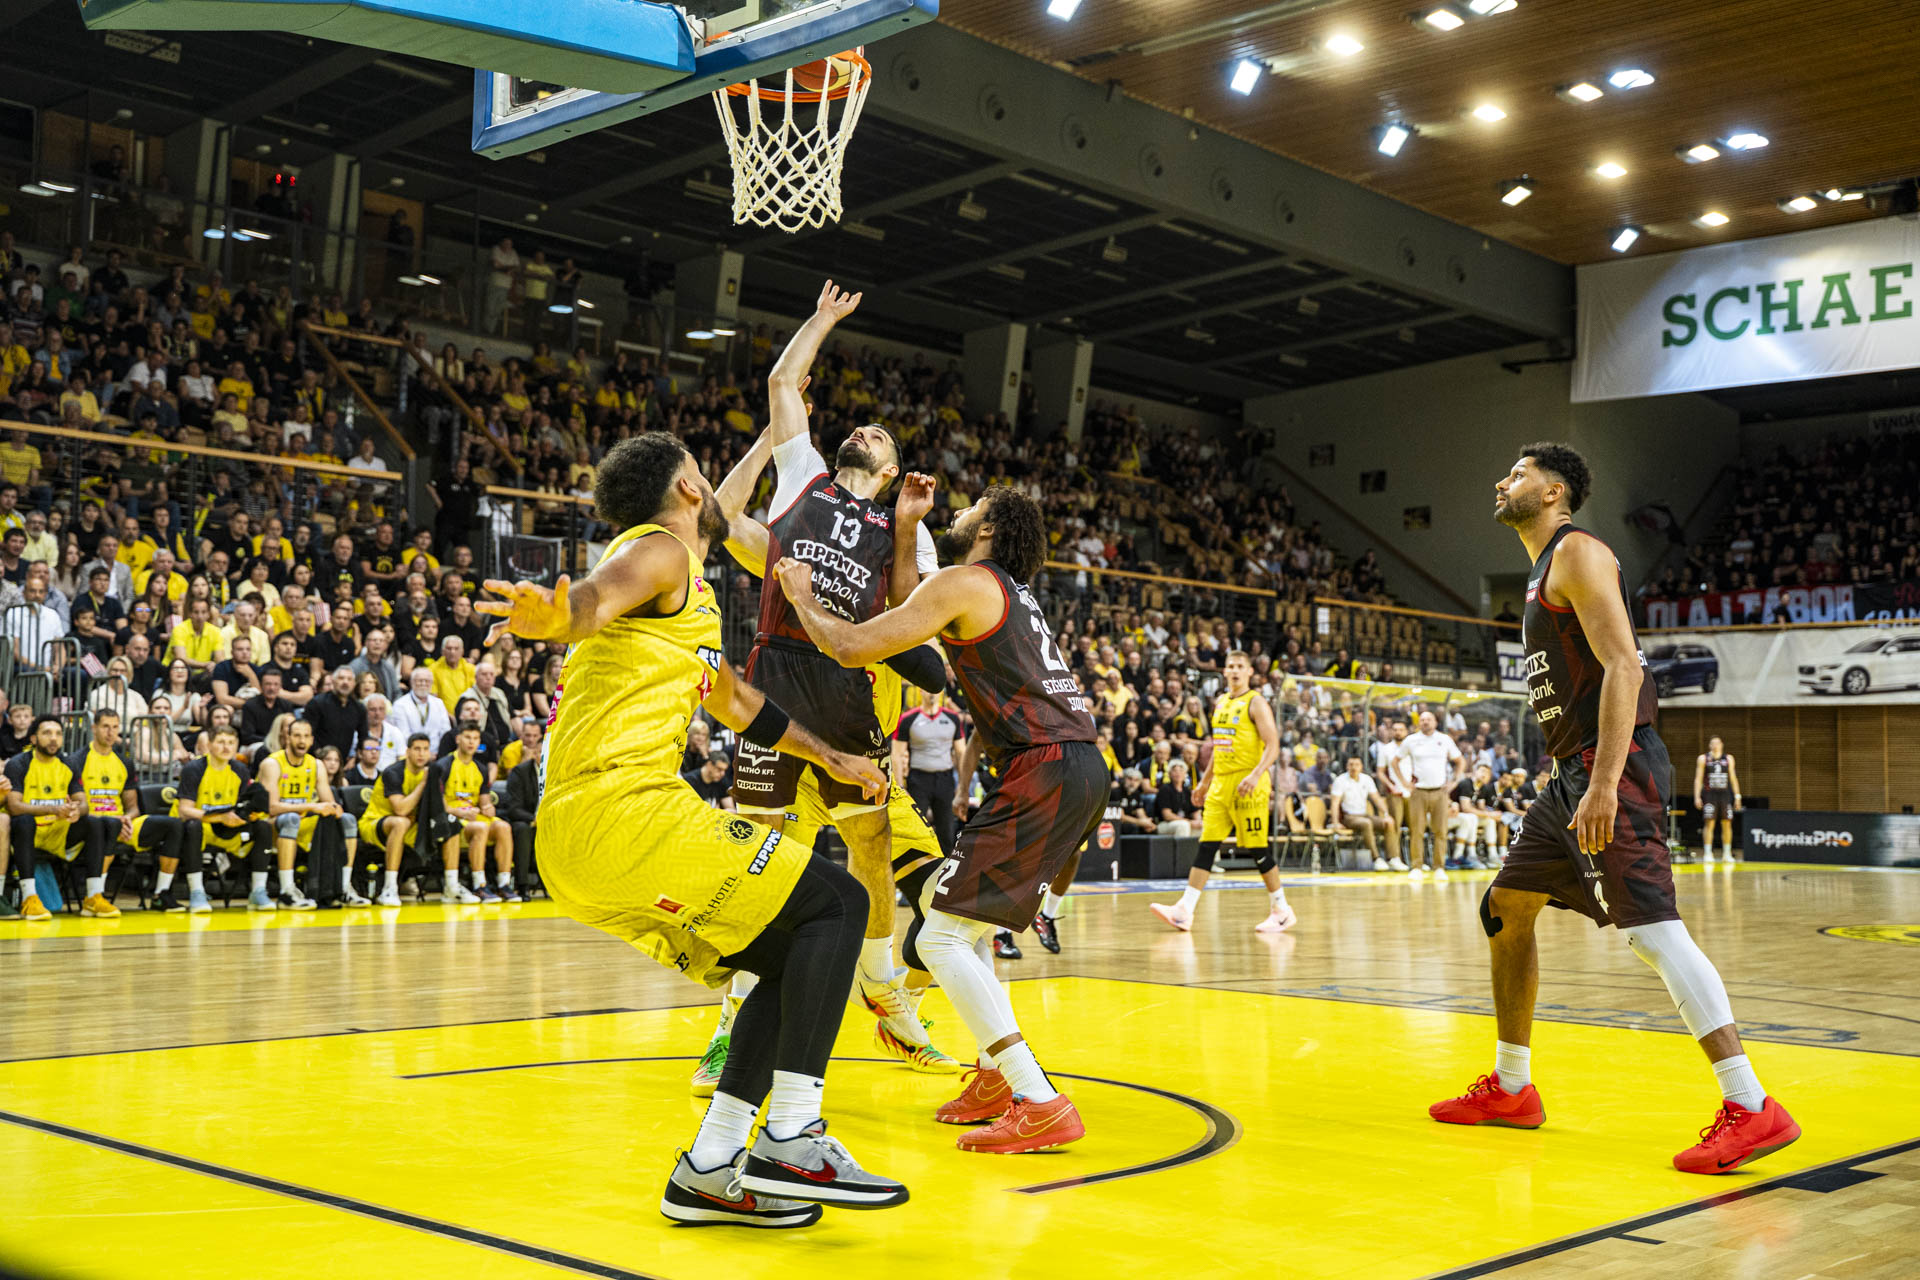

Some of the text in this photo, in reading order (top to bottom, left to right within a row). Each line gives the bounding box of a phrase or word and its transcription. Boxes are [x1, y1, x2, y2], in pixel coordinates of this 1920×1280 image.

[1661, 262, 1913, 348] SCHAE
[829, 510, 862, 549] 13
[1245, 817, 1262, 832] 10
[1750, 828, 1854, 849] TippmixPRO
[707, 875, 738, 911] HOTEL
